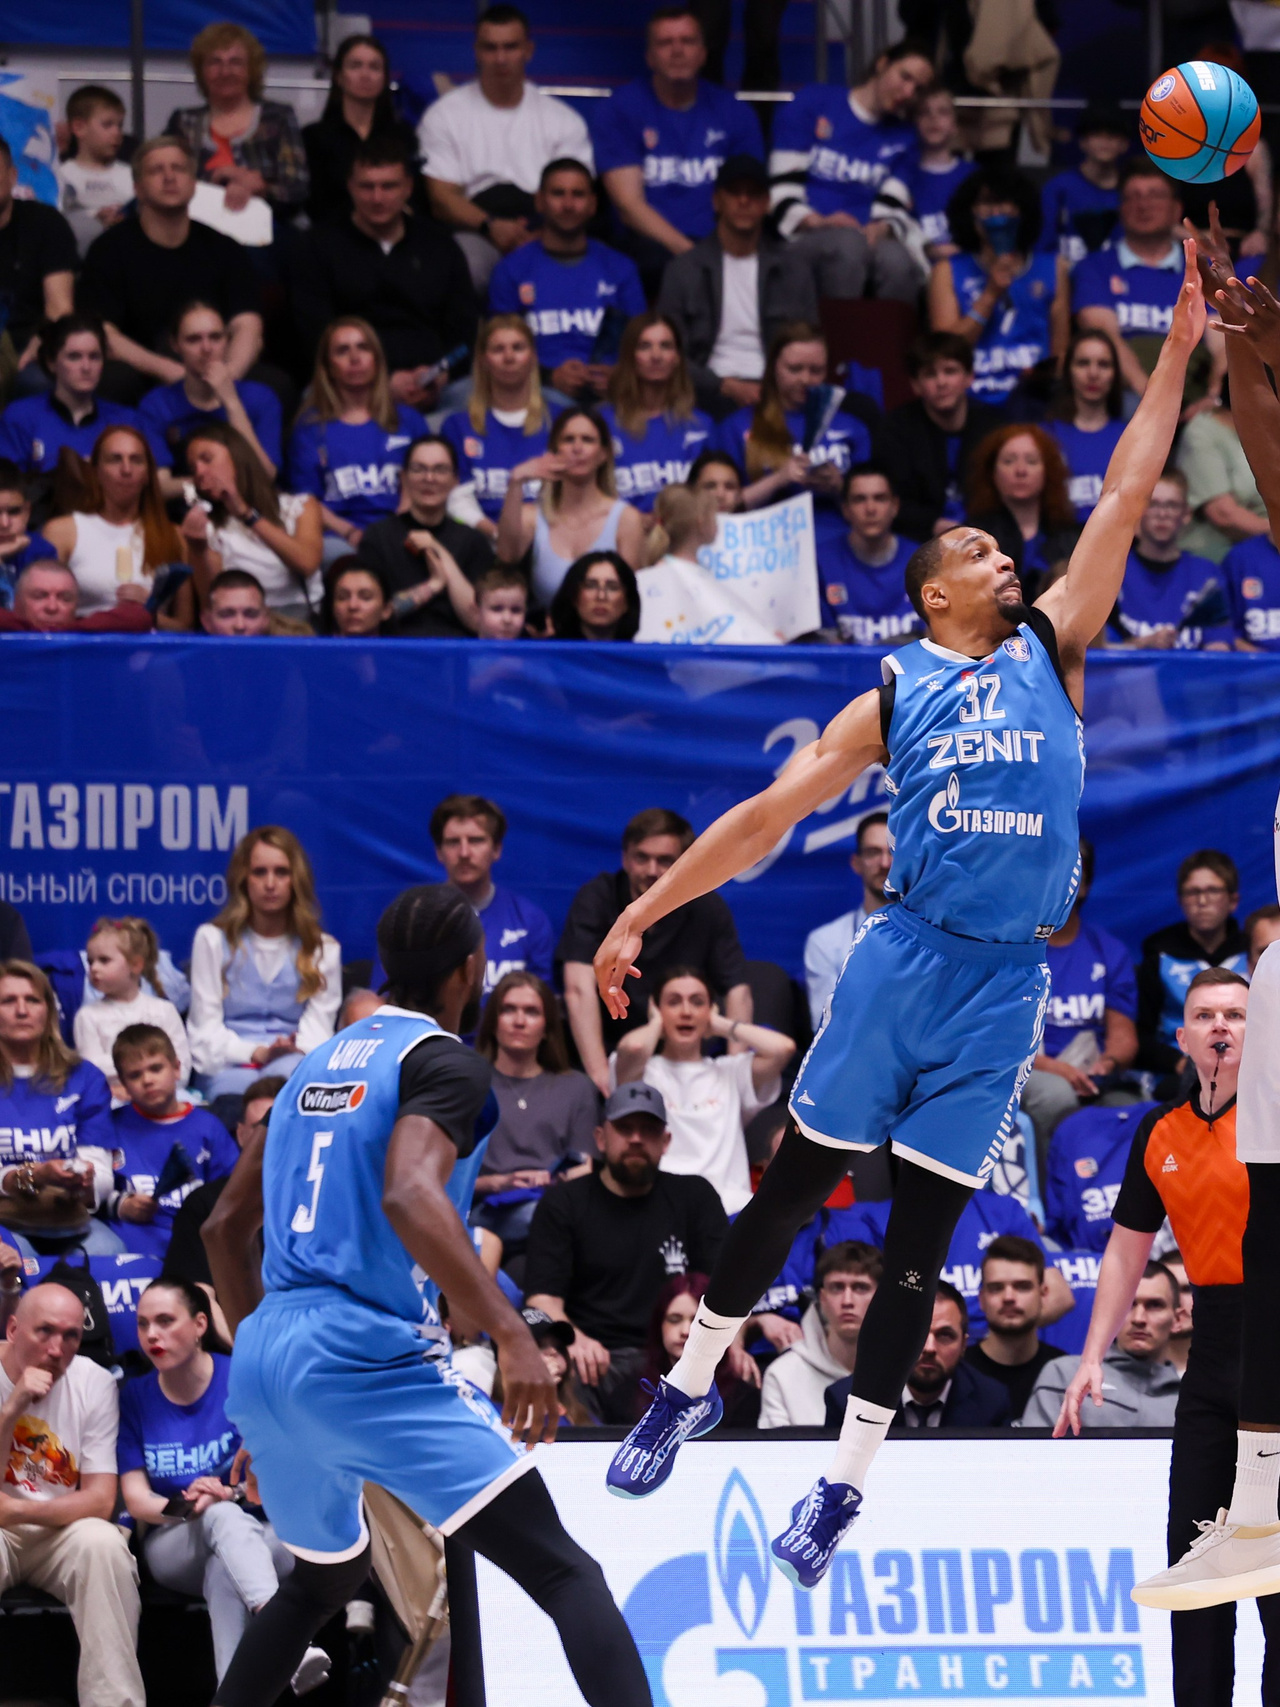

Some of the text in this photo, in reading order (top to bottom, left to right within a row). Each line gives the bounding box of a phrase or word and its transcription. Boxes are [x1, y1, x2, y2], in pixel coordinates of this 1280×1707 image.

[956, 674, 1006, 723] 32
[927, 730, 1046, 769] ZENIT
[962, 809, 1044, 837] ГАЗПРОМ
[327, 1039, 384, 1070] WHITE
[291, 1131, 333, 1233] 5
[809, 1653, 1137, 1691] ТРАНСГАЗ
